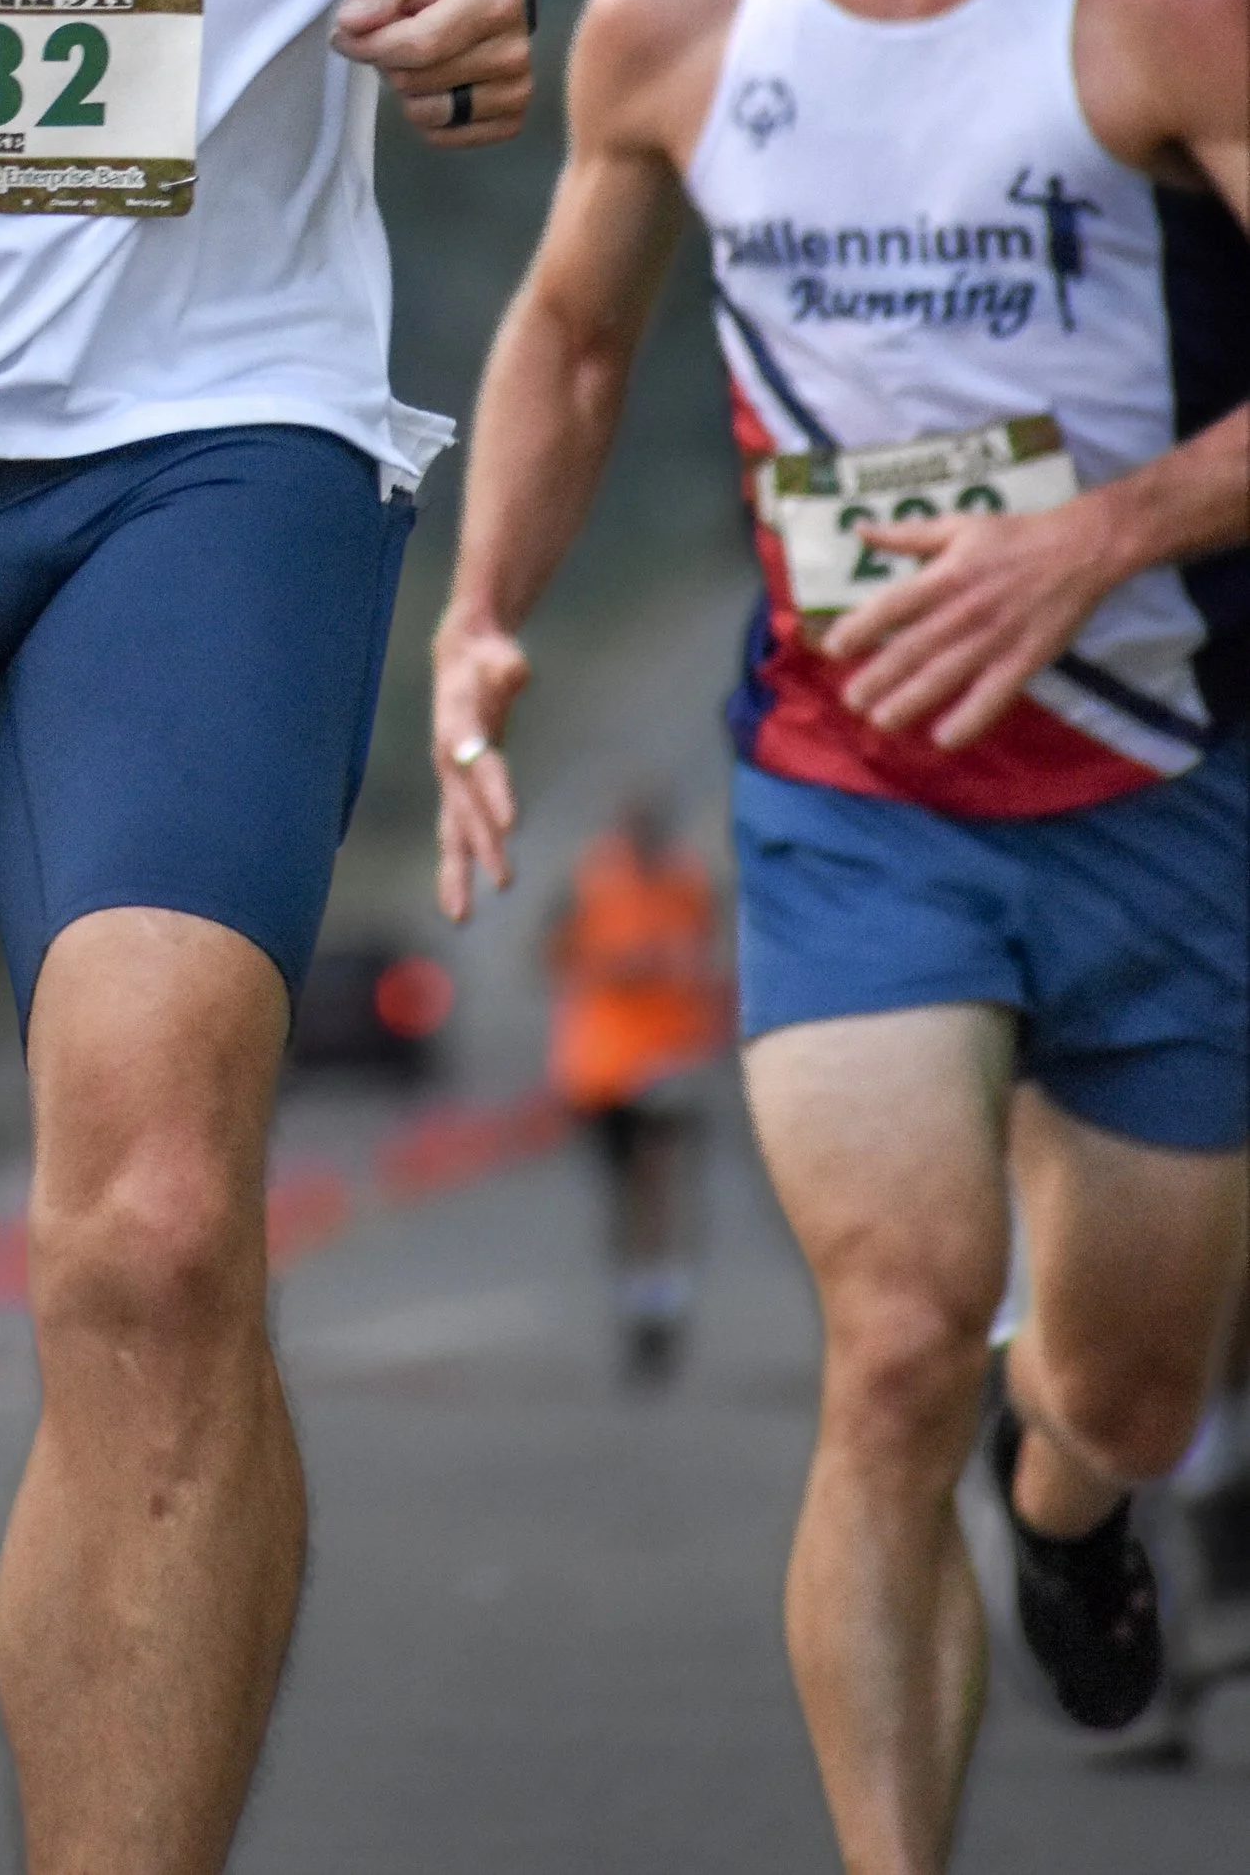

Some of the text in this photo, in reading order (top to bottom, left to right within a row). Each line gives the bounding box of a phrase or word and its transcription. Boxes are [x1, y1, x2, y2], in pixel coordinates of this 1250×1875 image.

[6, 166, 144, 191] Enterprise Bank
[790, 270, 1037, 339] Running
